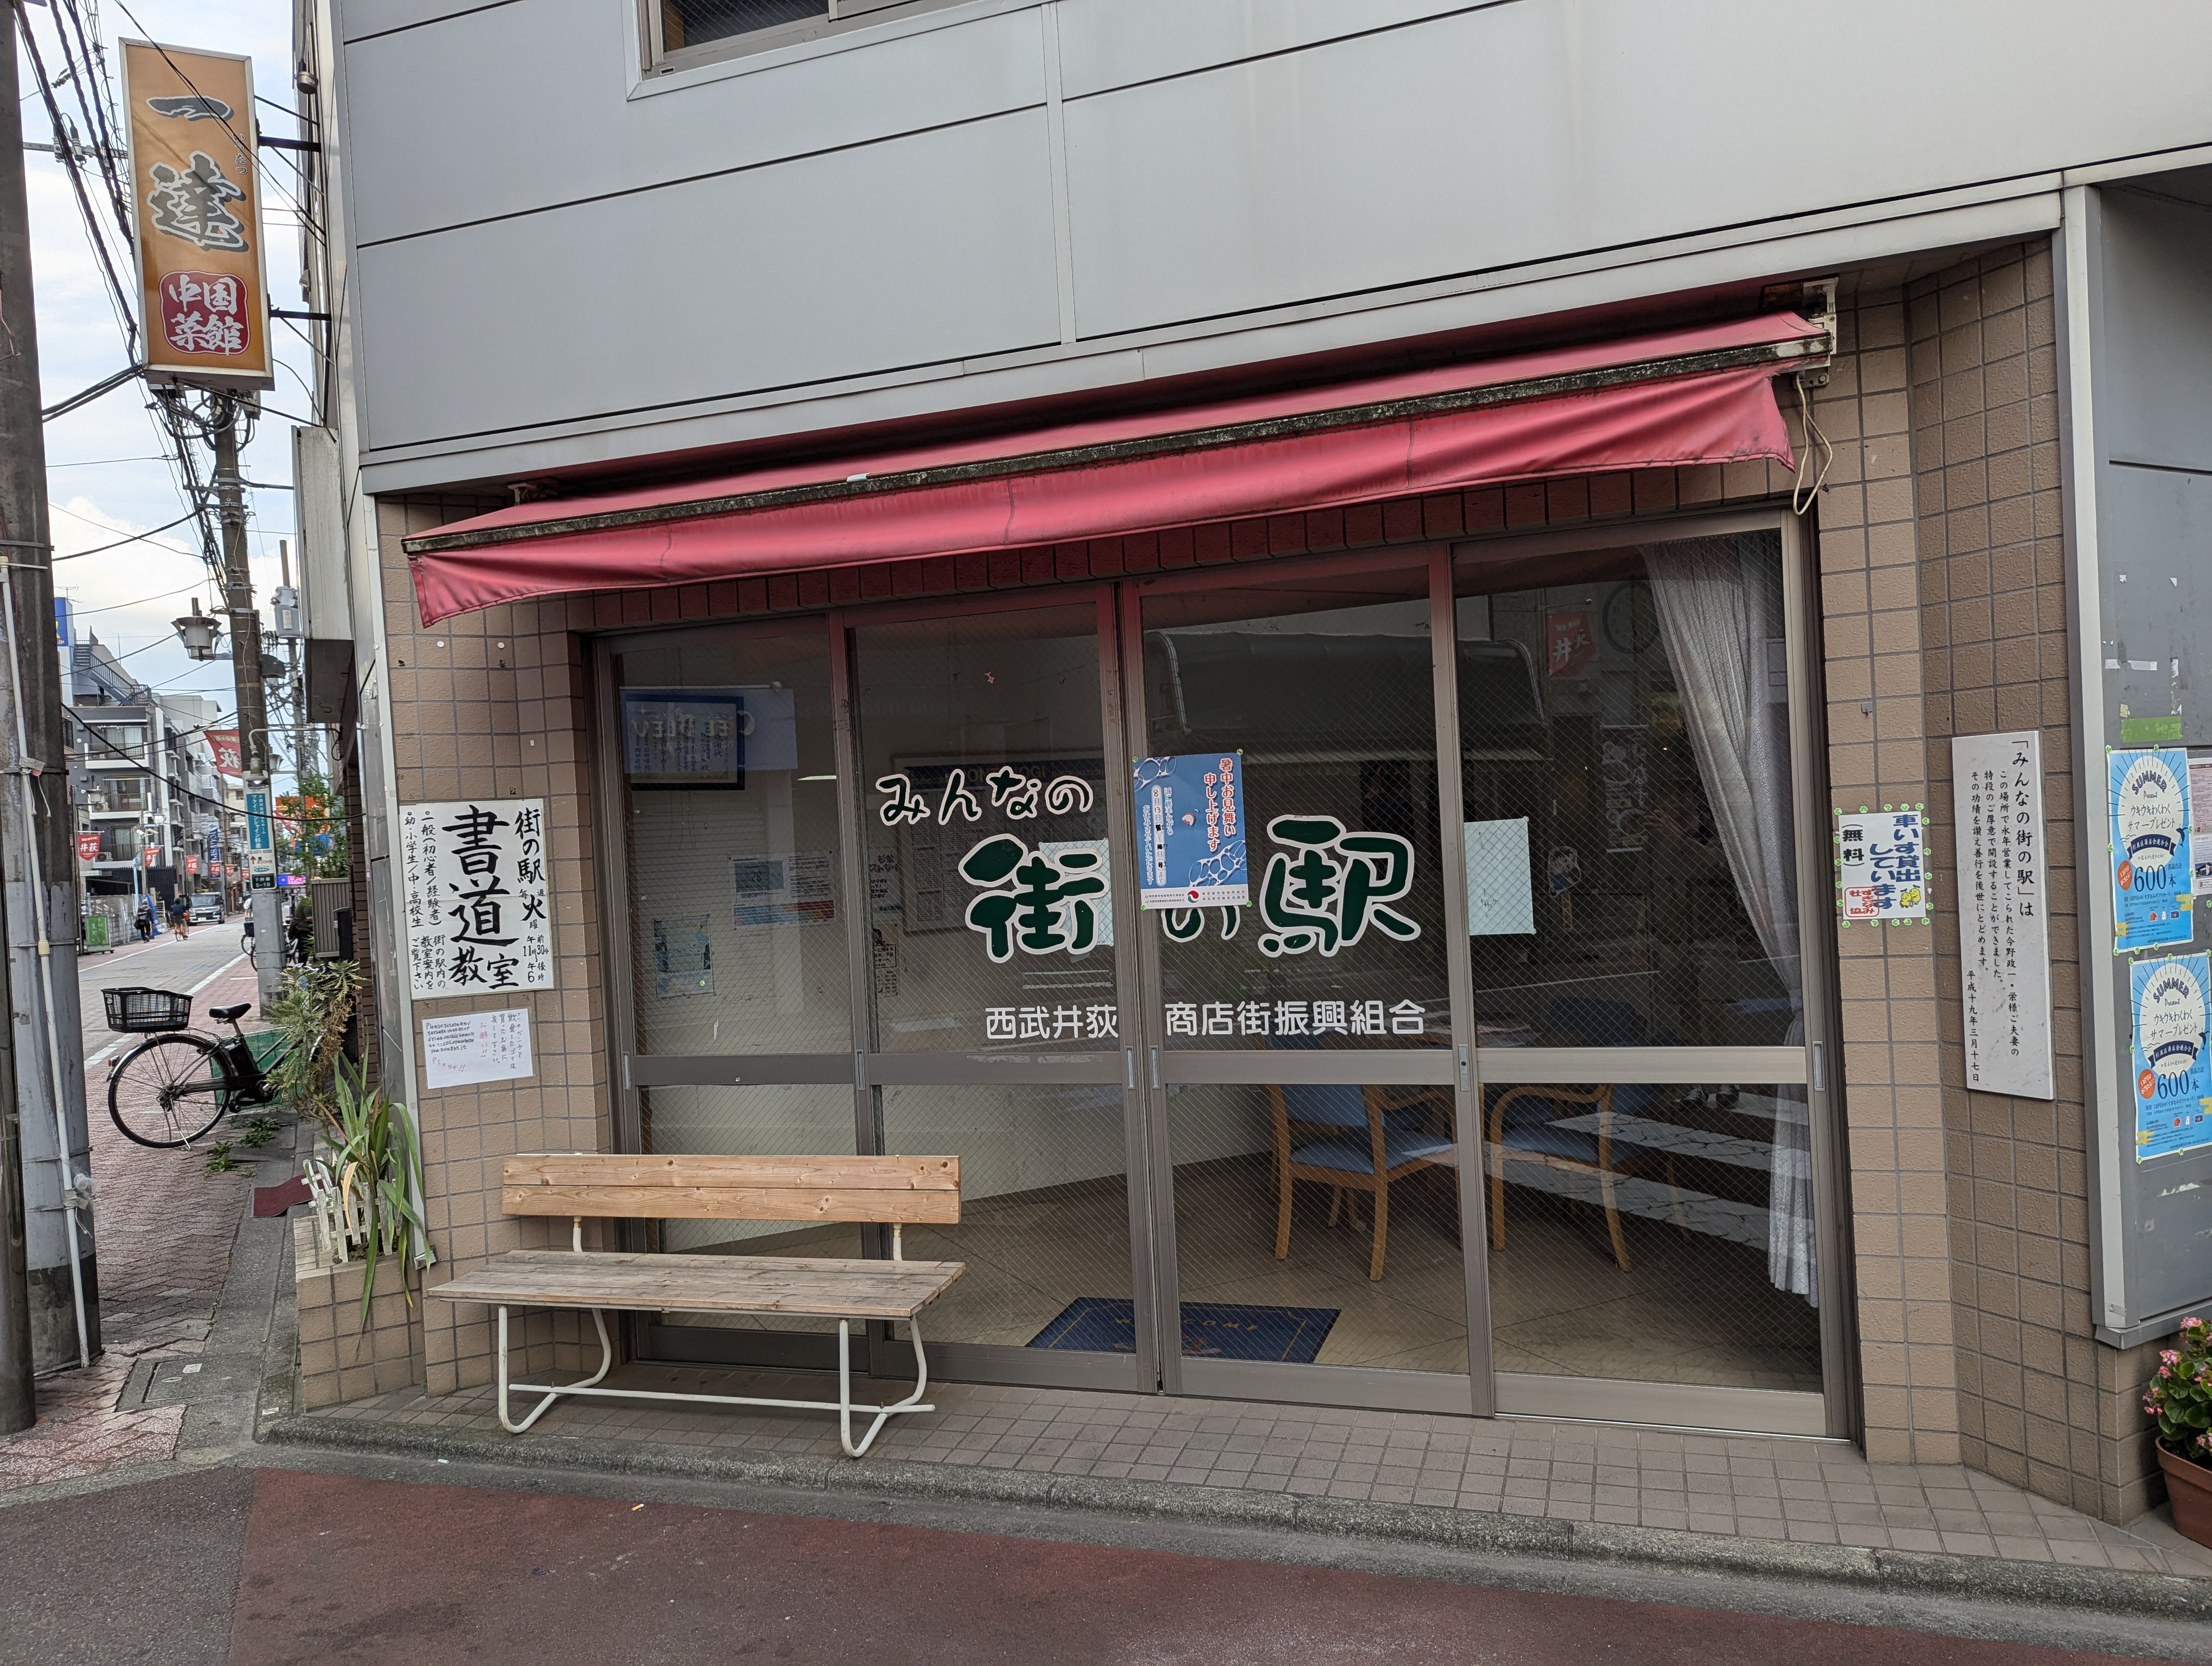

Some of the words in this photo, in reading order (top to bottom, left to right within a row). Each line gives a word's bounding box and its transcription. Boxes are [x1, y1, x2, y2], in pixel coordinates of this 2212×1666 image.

[169, 274, 237, 314] 中国
[170, 312, 244, 356] 菜館
[876, 766, 1094, 825] みんなの
[1219, 758, 1236, 837] 暑中お見舞い
[2132, 770, 2167, 796] SUMMER
[1163, 787, 1174, 836] 誠に勝手ながら
[1204, 772, 1219, 853] 申し上げます
[2011, 740, 2035, 917] 「みんなの街の駅」は
[2128, 817, 2175, 831] サマープレゼント
[2131, 803, 2171, 817] ウキウキわくわく
[80, 842, 98, 852] 井荻
[514, 806, 546, 885] 街の駅
[1142, 805, 1154, 886] お休みさせていただきます
[1842, 824, 1864, 867] (無料)
[1893, 814, 1921, 882] 車いす貸出
[1869, 843, 1897, 909] しています
[411, 937, 423, 990] ご覧下さい
[420, 935, 435, 990] 教室案内を
[433, 934, 448, 988] 街の駅内の
[2153, 977, 2189, 1003] SUMMER
[1967, 970, 1979, 1082] 平成十九年三月十七日
[2150, 1022, 2197, 1040] サマープレゼント
[2154, 1009, 2193, 1026] ウキウキわくわく
[1115, 1317, 1258, 1331] WCOME
